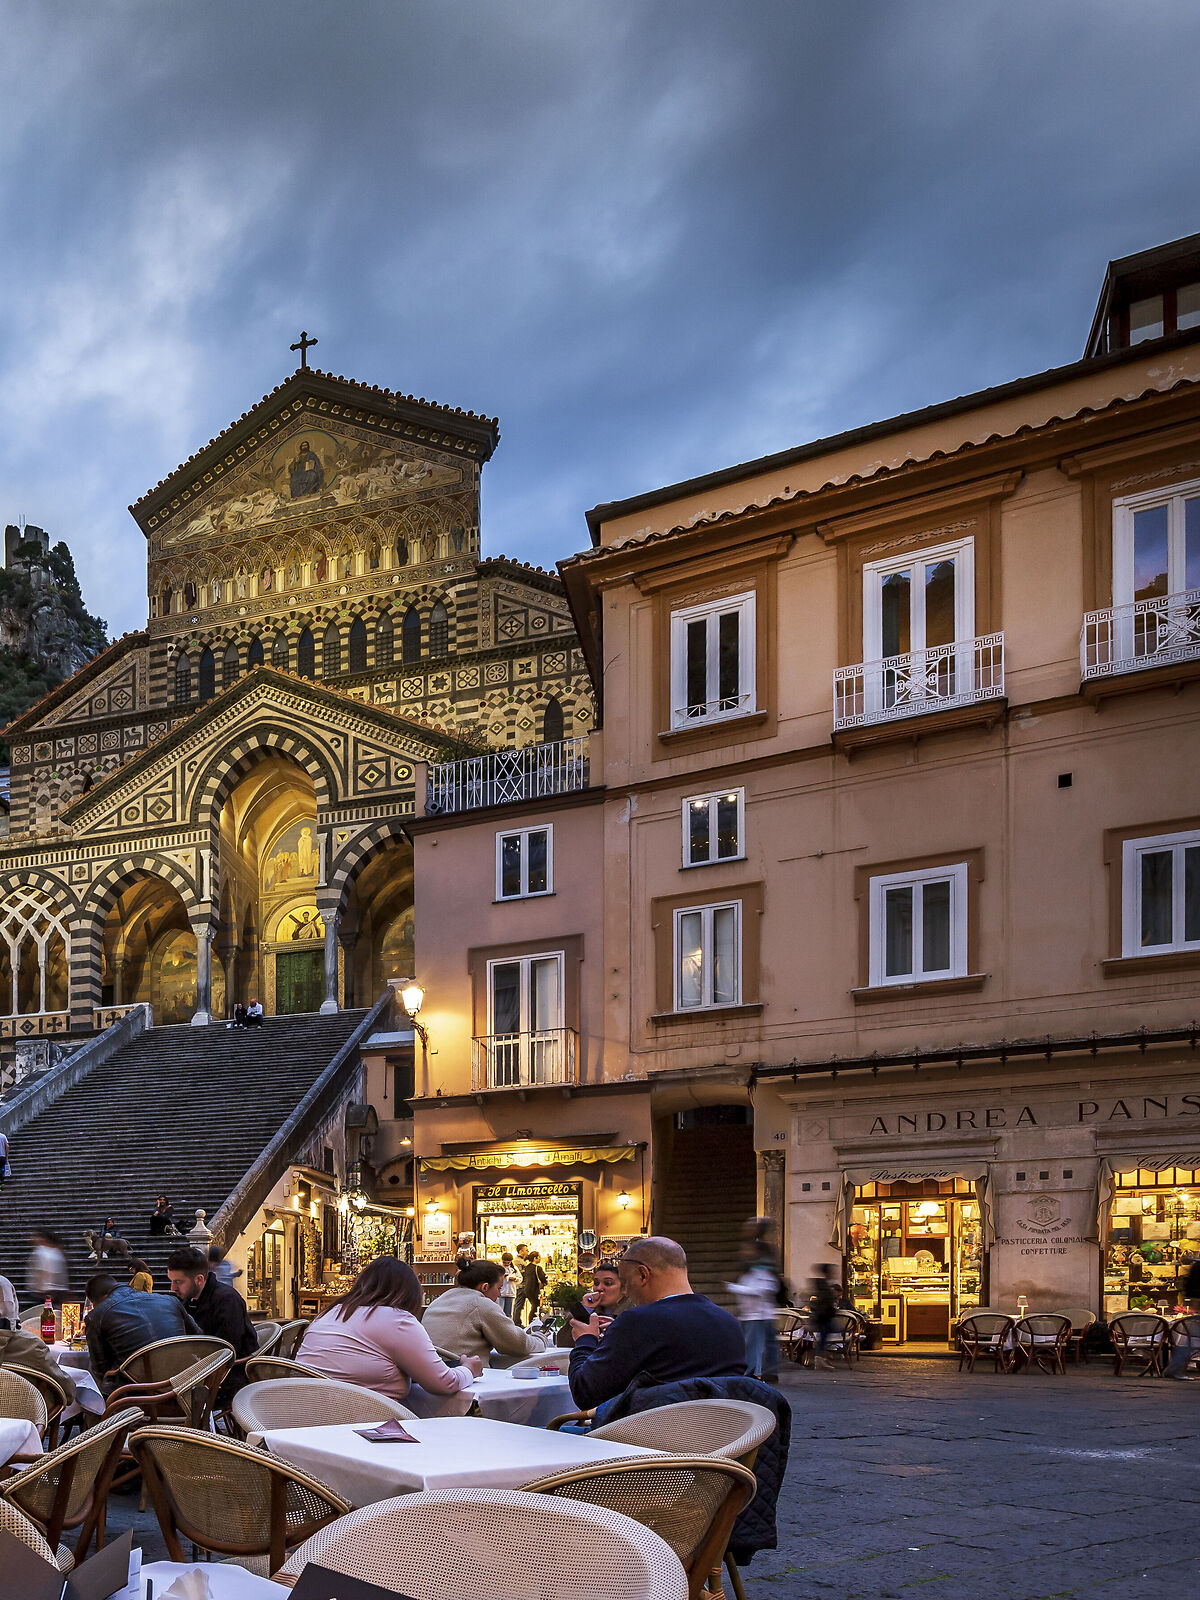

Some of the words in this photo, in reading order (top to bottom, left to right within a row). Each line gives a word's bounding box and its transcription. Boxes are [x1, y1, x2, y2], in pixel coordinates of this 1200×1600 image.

[869, 1106, 1039, 1135] ANDREA
[1078, 1095, 1200, 1122] PANS
[774, 1133, 785, 1141] 40
[469, 1155, 502, 1166] Antichi
[869, 1169, 958, 1181] Pasticceria
[487, 1186, 501, 1197] Il
[1001, 1237, 1048, 1246] PASTICCERIA
[1020, 1247, 1068, 1256] CONFETTURE
